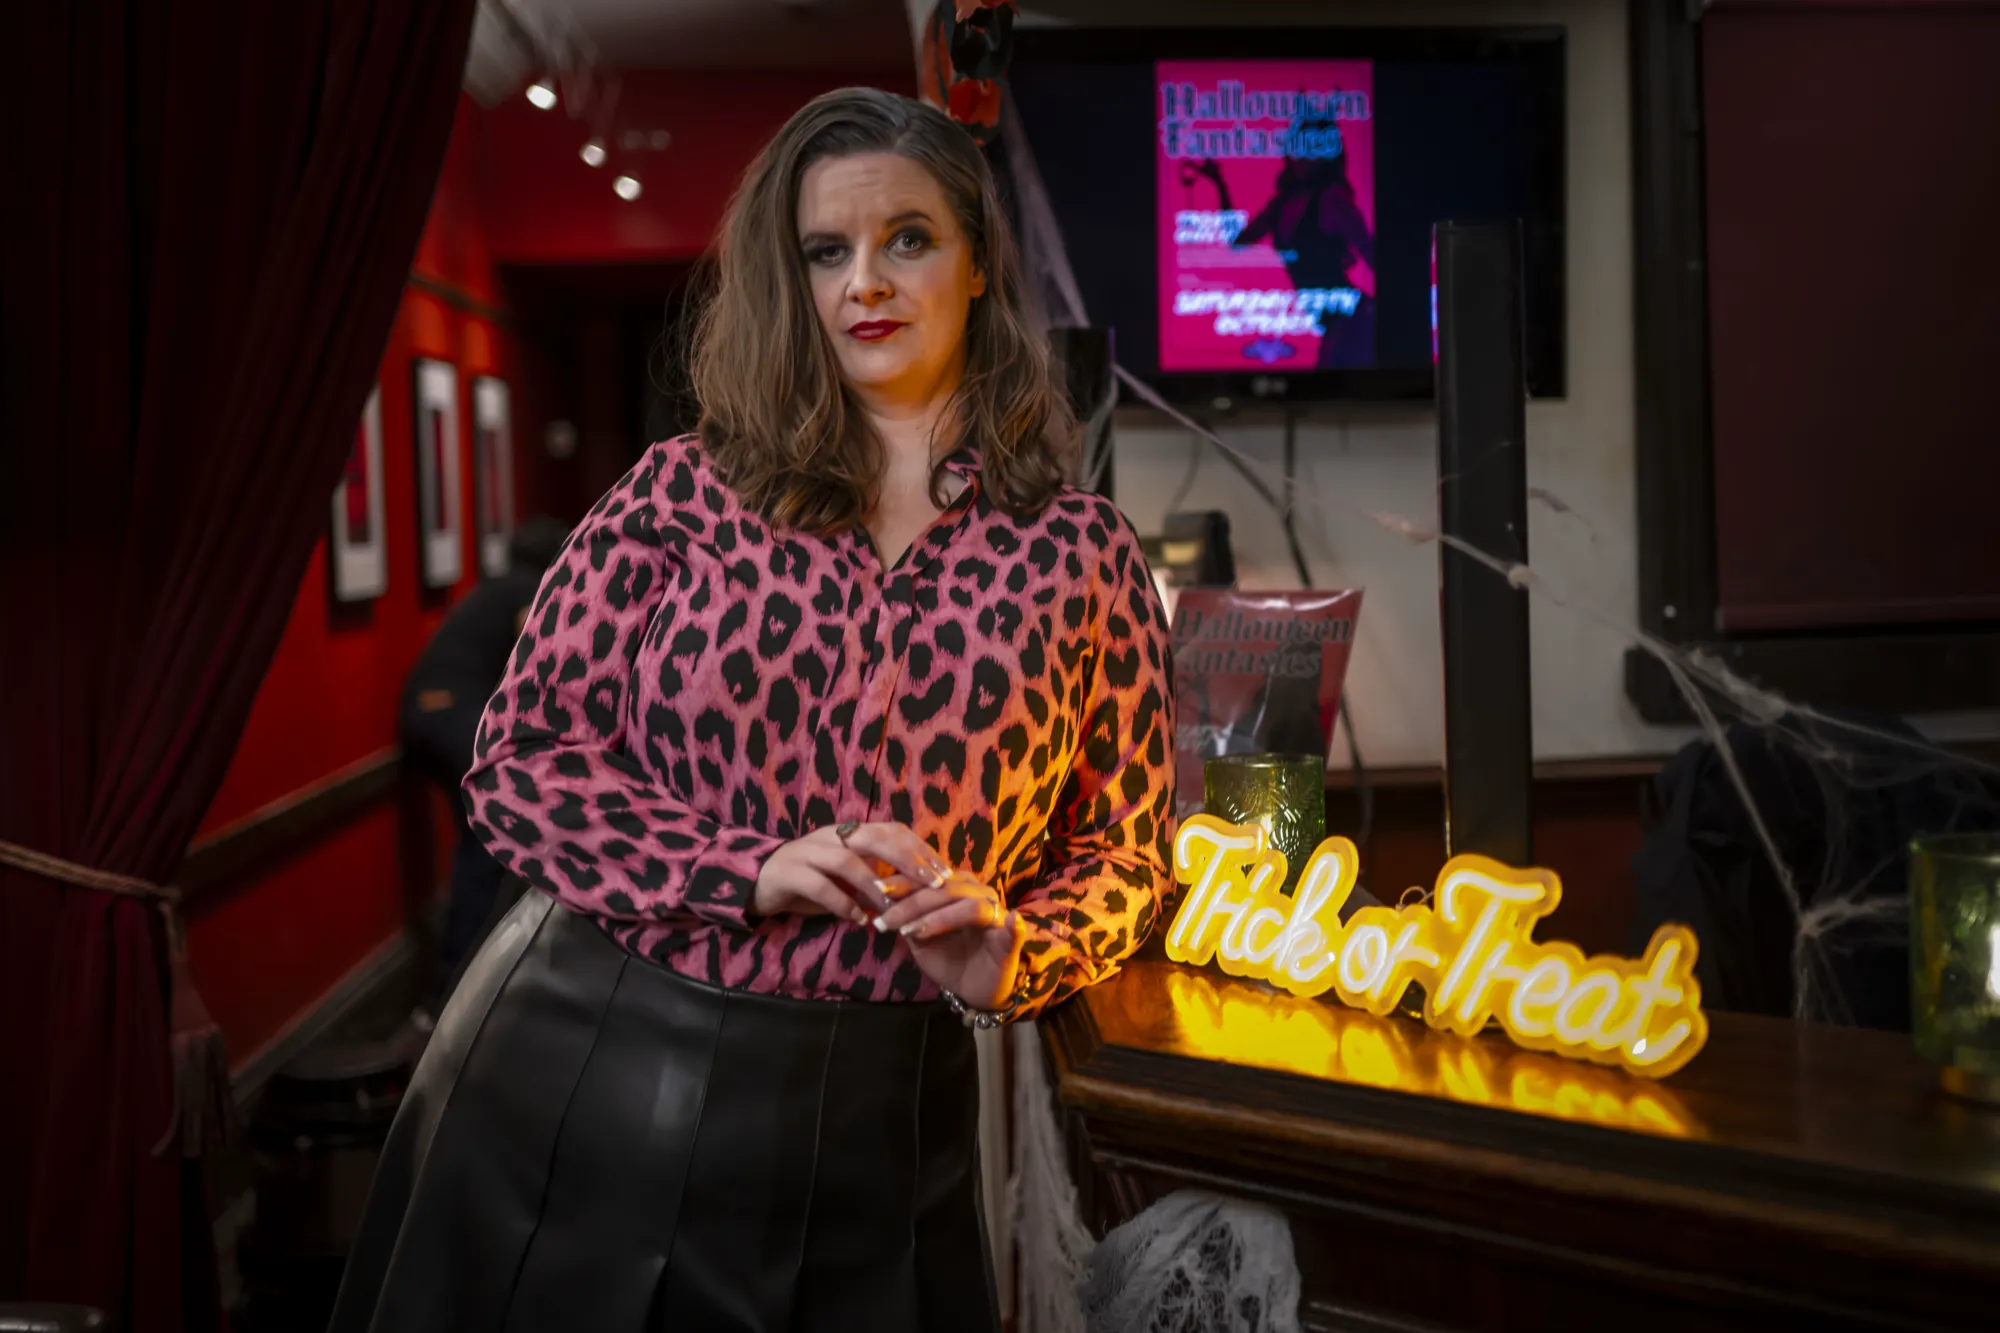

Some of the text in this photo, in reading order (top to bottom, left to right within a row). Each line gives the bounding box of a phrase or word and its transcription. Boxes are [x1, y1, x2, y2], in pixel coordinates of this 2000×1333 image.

[1161, 80, 1371, 121] Halloween
[1159, 116, 1342, 159] Fantasies
[1174, 607, 1352, 643] Halloween
[1168, 822, 1693, 1067] Trick or Treat
